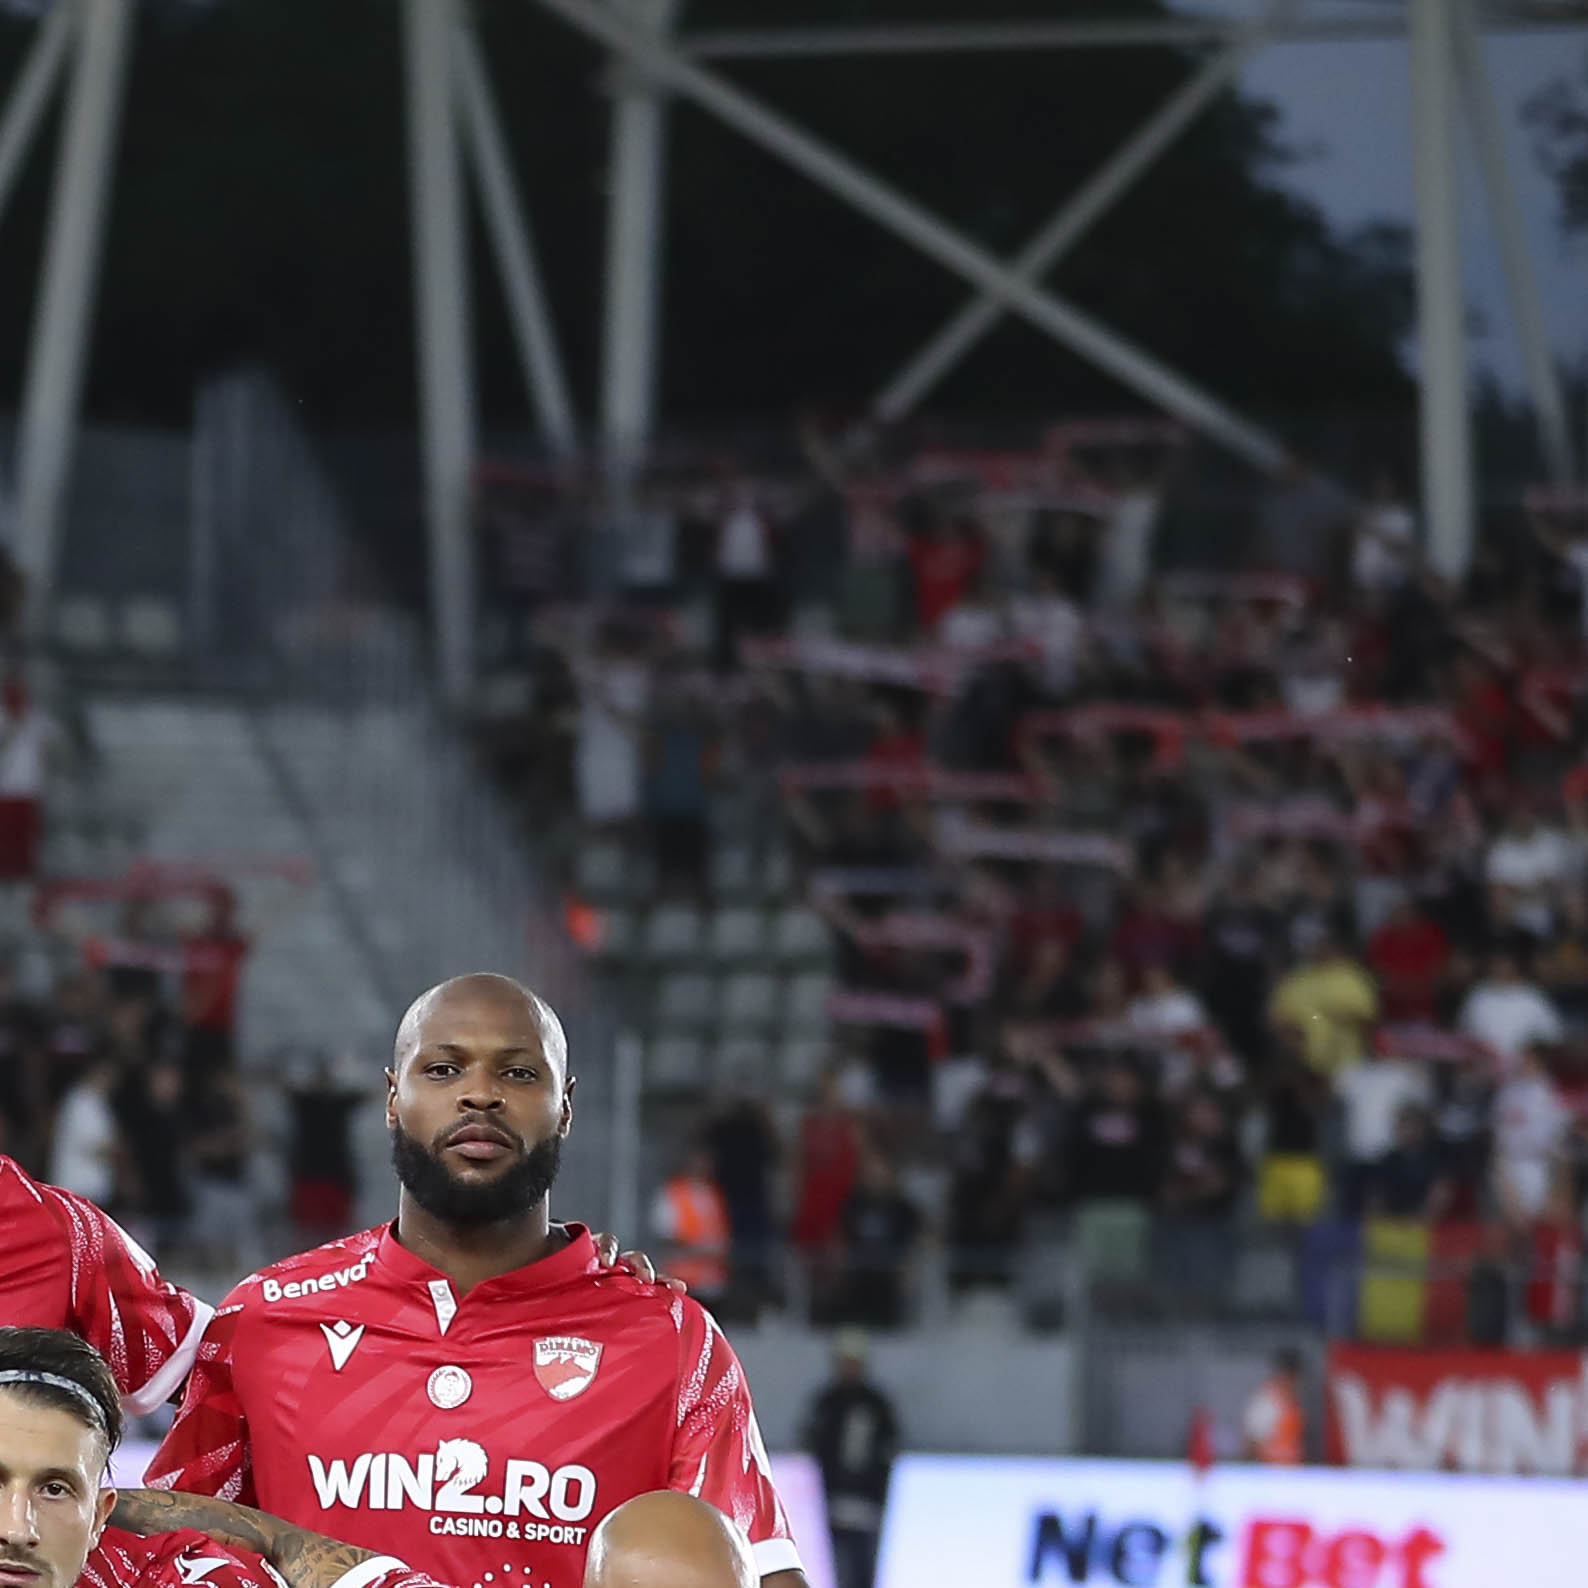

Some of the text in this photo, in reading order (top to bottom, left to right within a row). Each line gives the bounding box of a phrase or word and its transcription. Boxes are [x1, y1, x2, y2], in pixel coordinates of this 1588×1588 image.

[262, 1261, 368, 1303] Beneva
[307, 1437, 597, 1522] WIN2.RO
[429, 1516, 588, 1545] CASINO & SPORT
